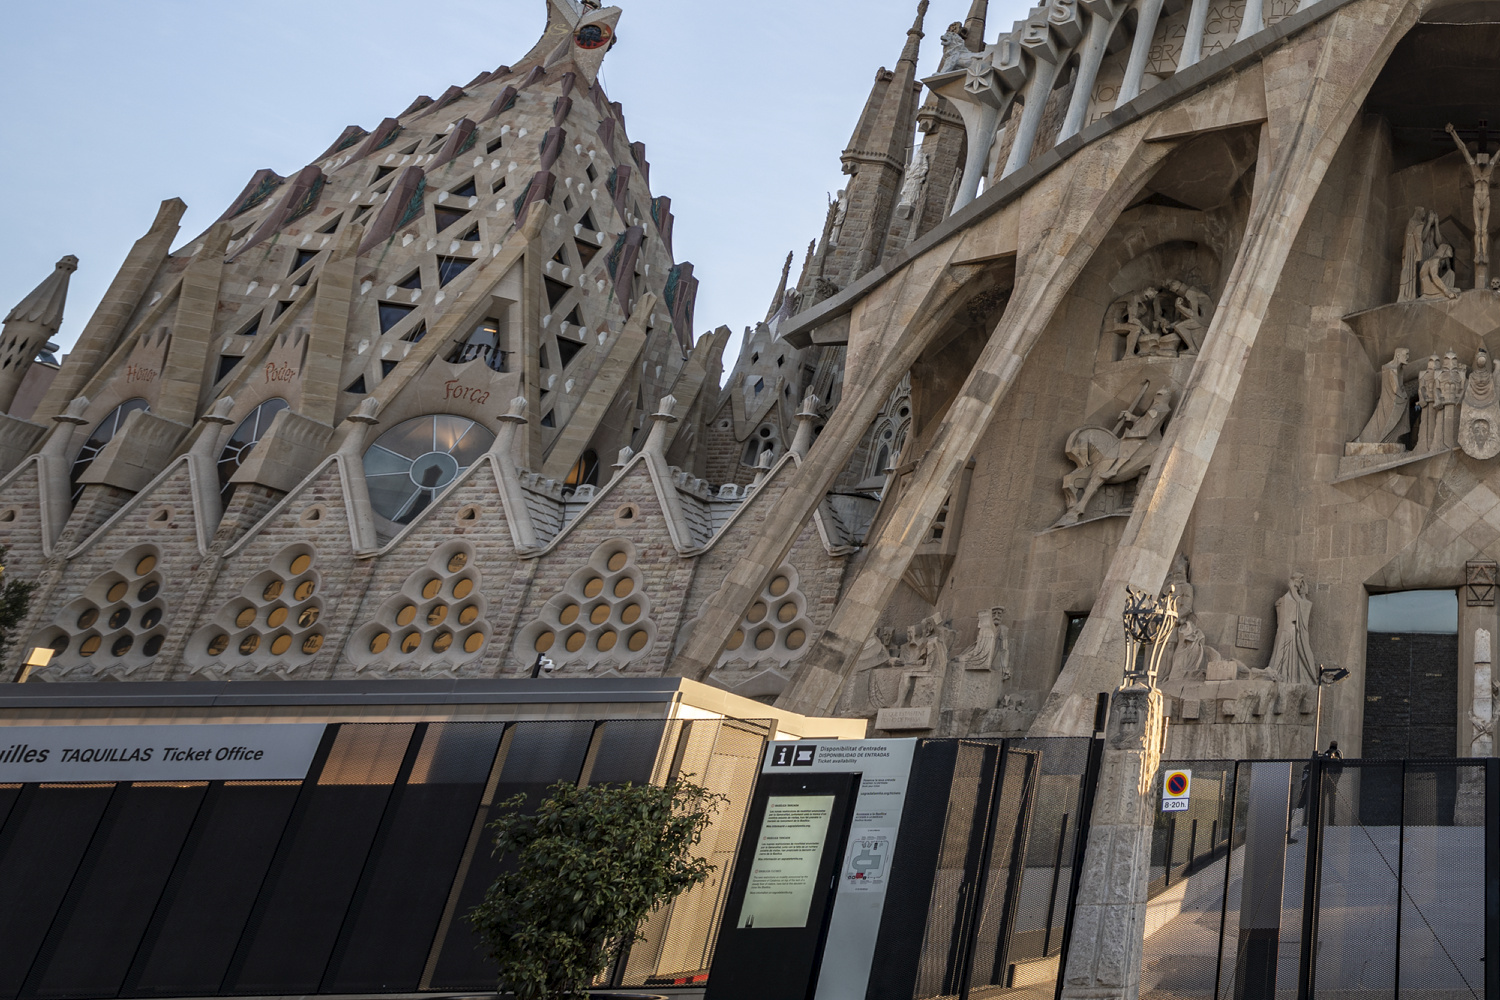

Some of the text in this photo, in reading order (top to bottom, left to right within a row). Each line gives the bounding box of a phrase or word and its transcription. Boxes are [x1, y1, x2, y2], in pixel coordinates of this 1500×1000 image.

[264, 361, 296, 384] Poder
[443, 378, 490, 405] Força
[59, 747, 154, 763] TAQUILLAS
[162, 747, 211, 762] Ticket
[214, 746, 264, 761] Office
